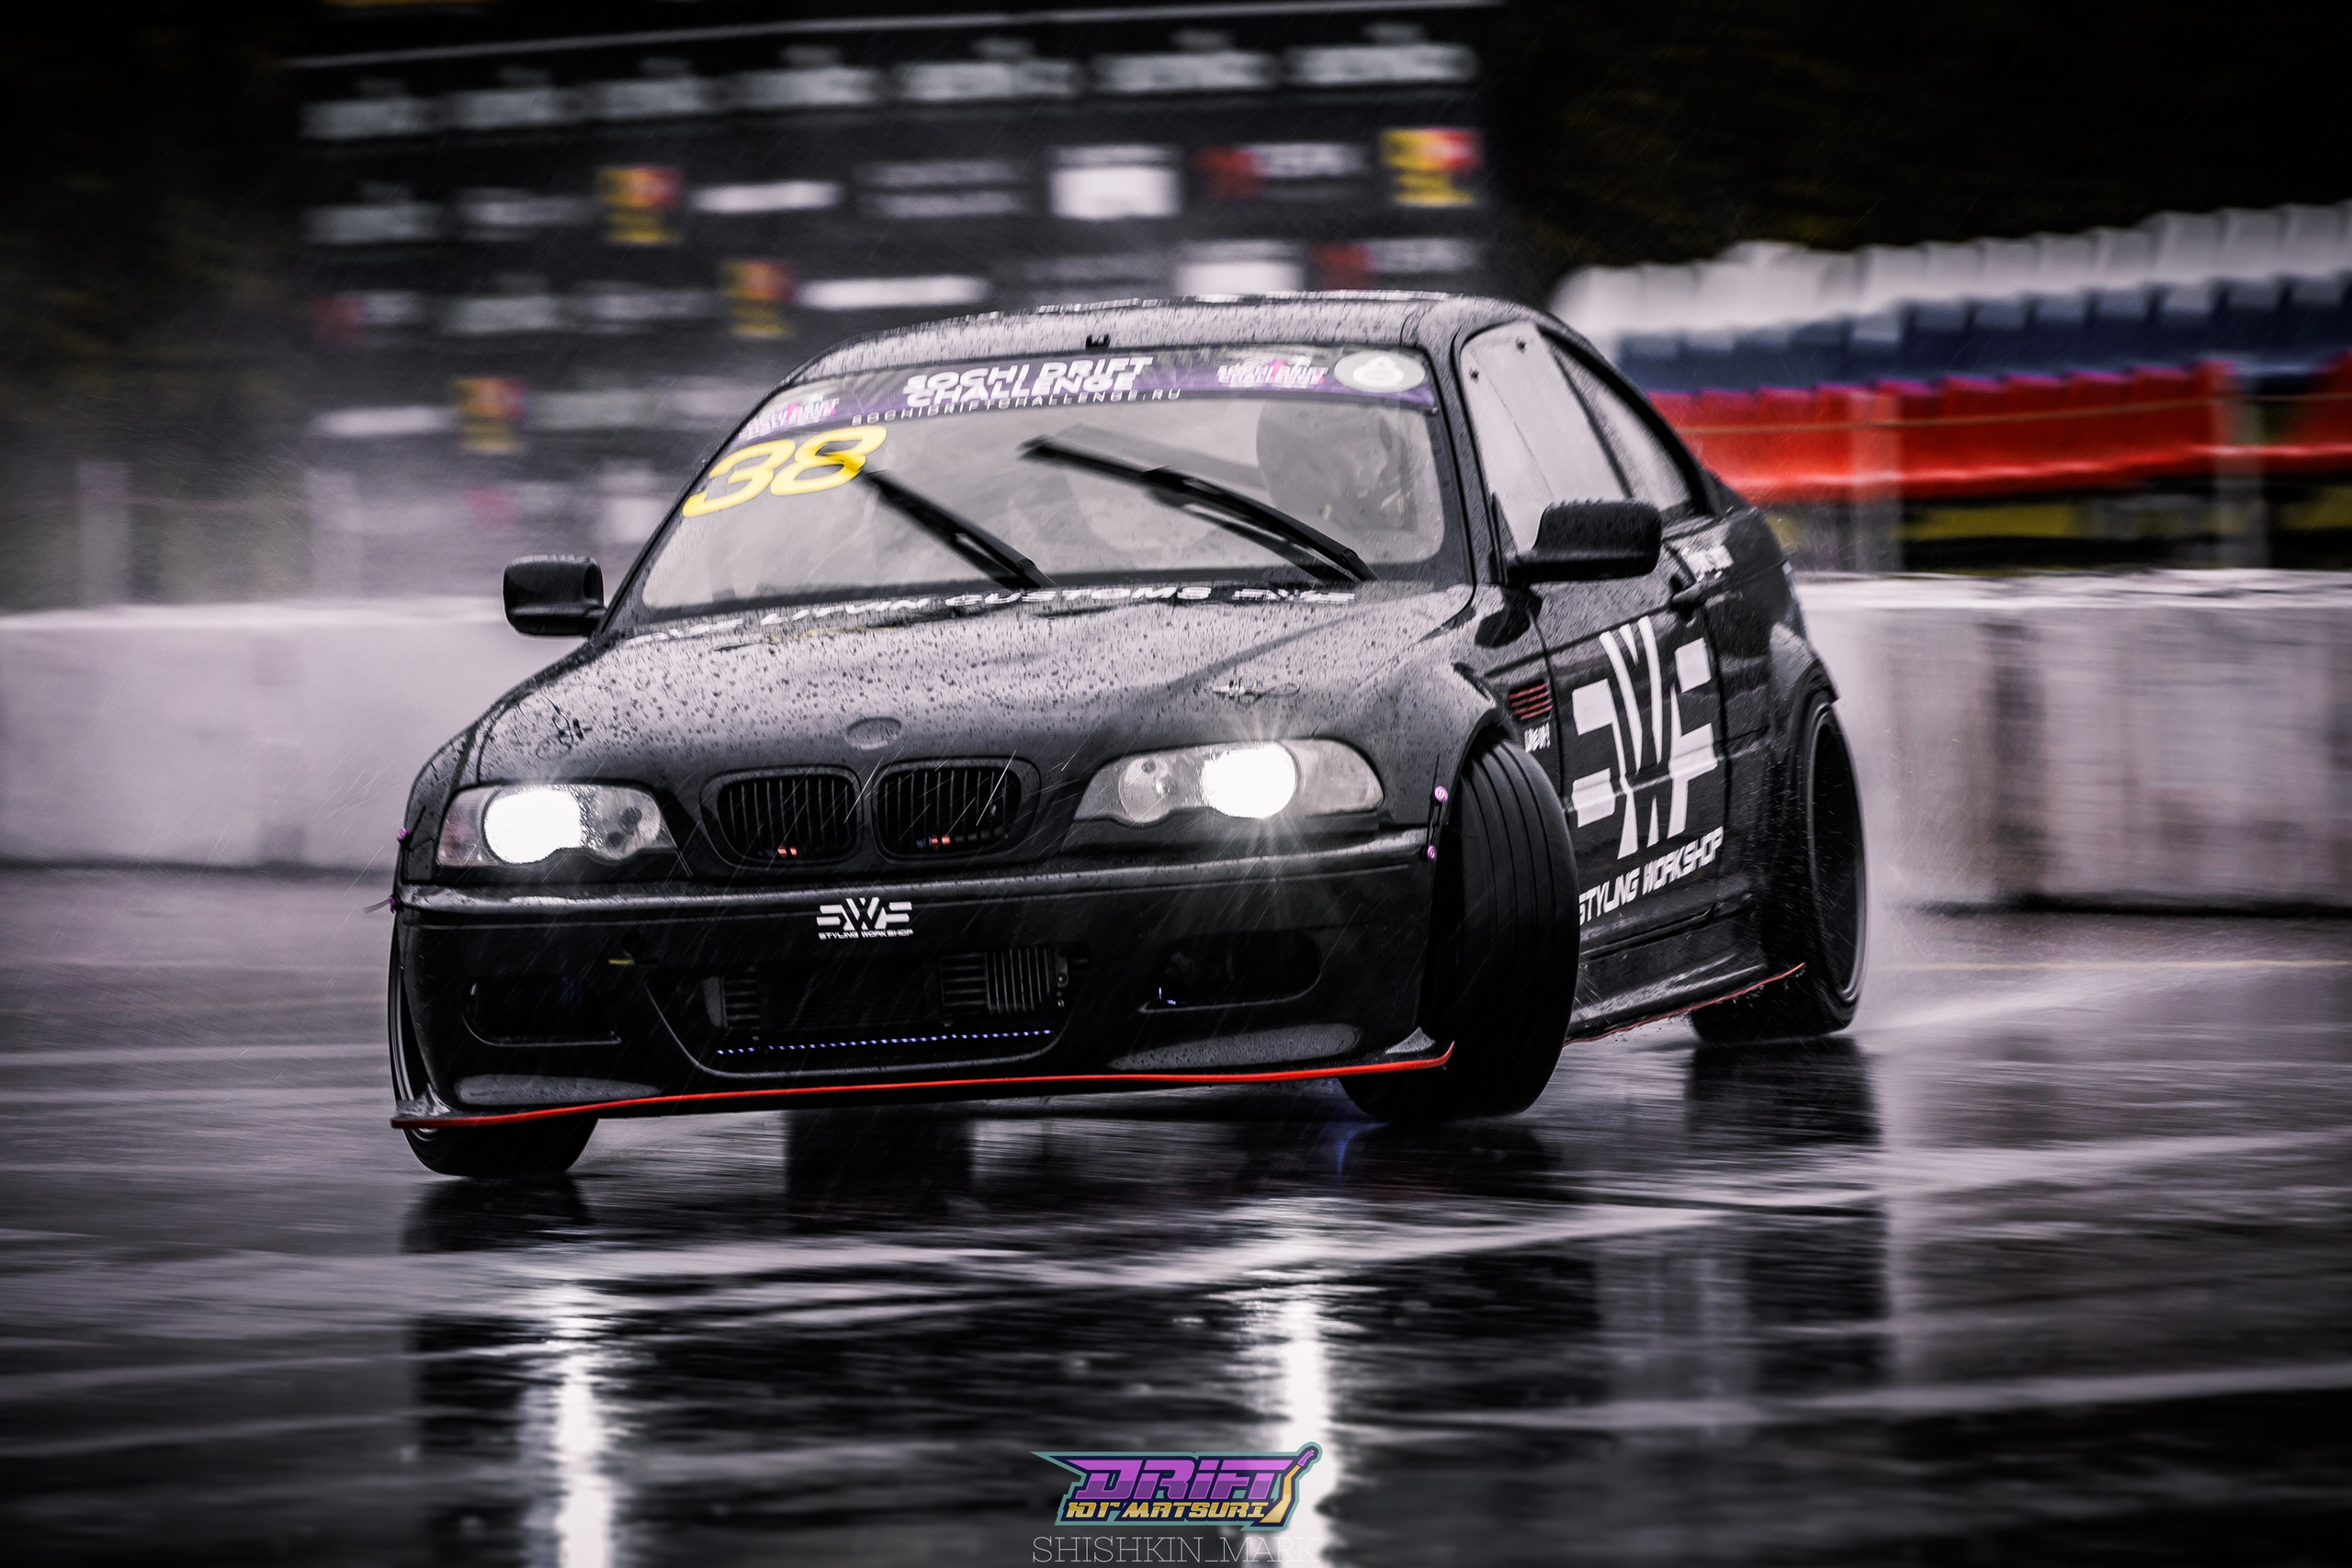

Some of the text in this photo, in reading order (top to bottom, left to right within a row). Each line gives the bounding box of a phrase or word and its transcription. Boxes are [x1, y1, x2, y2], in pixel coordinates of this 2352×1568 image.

[903, 356, 1154, 396] SOCHI DRIFT
[907, 371, 1136, 408] CHALLENGE
[852, 388, 1182, 427] SOCHIDRIFTCHALLENGE.RU
[682, 425, 888, 518] 38
[944, 586, 1212, 607] CUSTOMS
[1578, 825, 1724, 926] STYLING WORKSHOP
[818, 929, 914, 941] STYLING WORKSHOP
